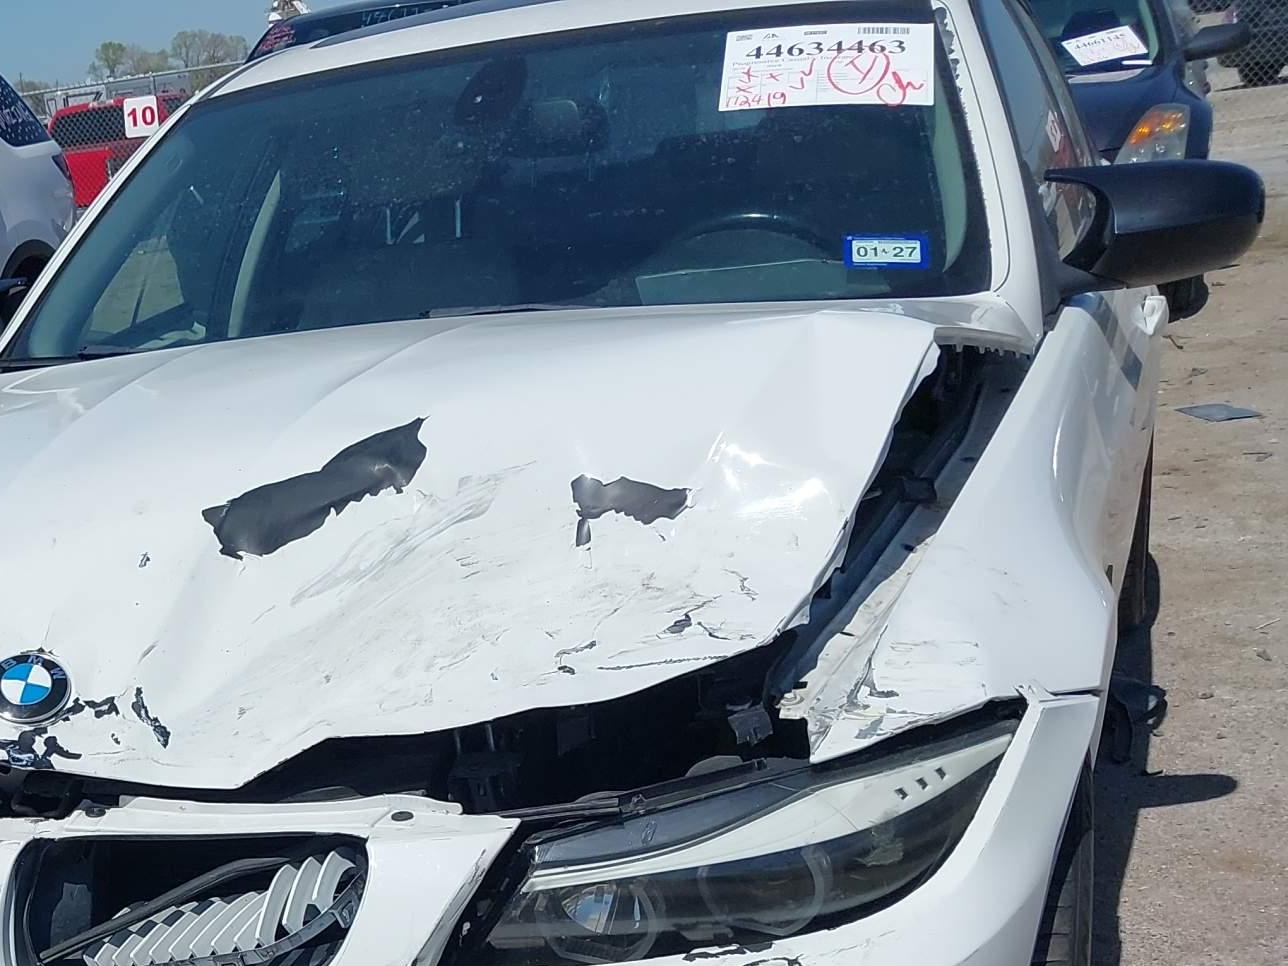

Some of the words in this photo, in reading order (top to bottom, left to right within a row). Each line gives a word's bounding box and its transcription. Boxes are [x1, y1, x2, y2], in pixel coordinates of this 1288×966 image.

[745, 39, 907, 59] 44634463
[127, 106, 156, 128] 10
[856, 246, 878, 258] 01
[892, 246, 918, 258] 27
[0, 655, 67, 680] BMW
